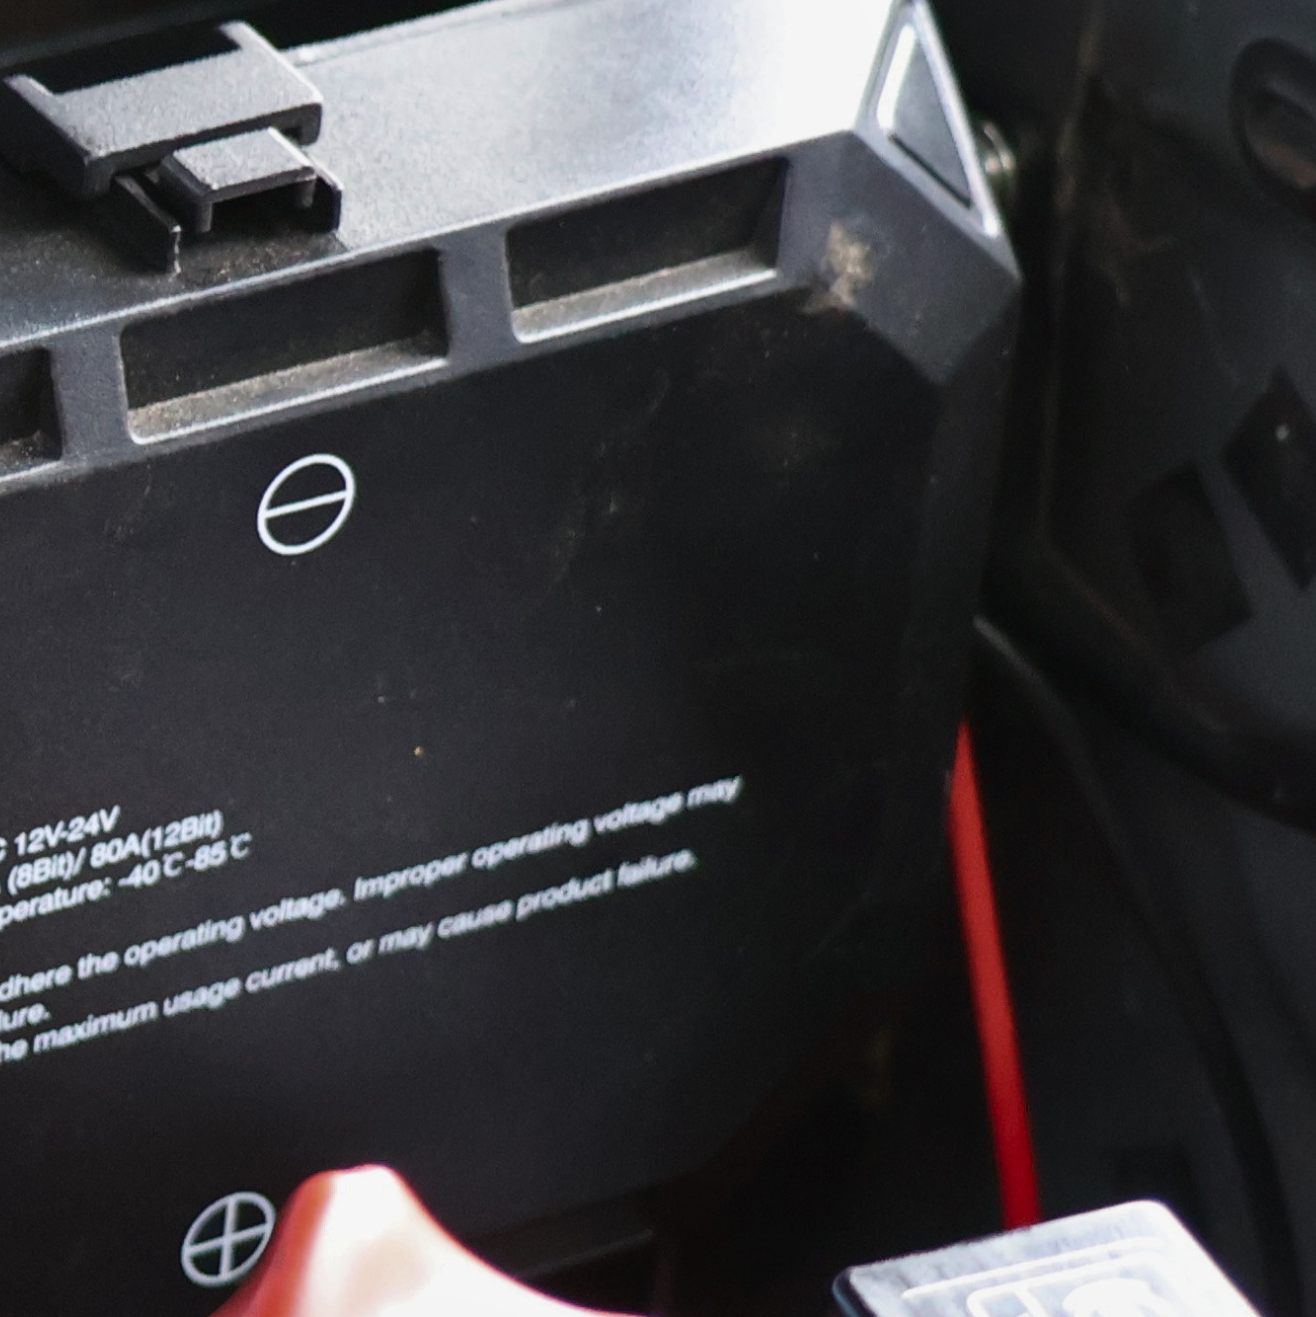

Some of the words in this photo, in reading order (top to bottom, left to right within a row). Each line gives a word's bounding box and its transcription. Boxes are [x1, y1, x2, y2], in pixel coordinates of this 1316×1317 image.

[12, 803, 121, 857] 12V-24V
[76, 950, 121, 980] the
[122, 914, 246, 967] operating
[352, 851, 469, 901] Improper
[470, 817, 591, 870] operating
[592, 791, 685, 833] voltage
[685, 775, 741, 807] may
[32, 1000, 159, 1053] maximum
[161, 976, 243, 1017] usage
[345, 937, 375, 965] or
[377, 921, 435, 954] may
[436, 899, 514, 939] cause
[514, 868, 614, 921] product
